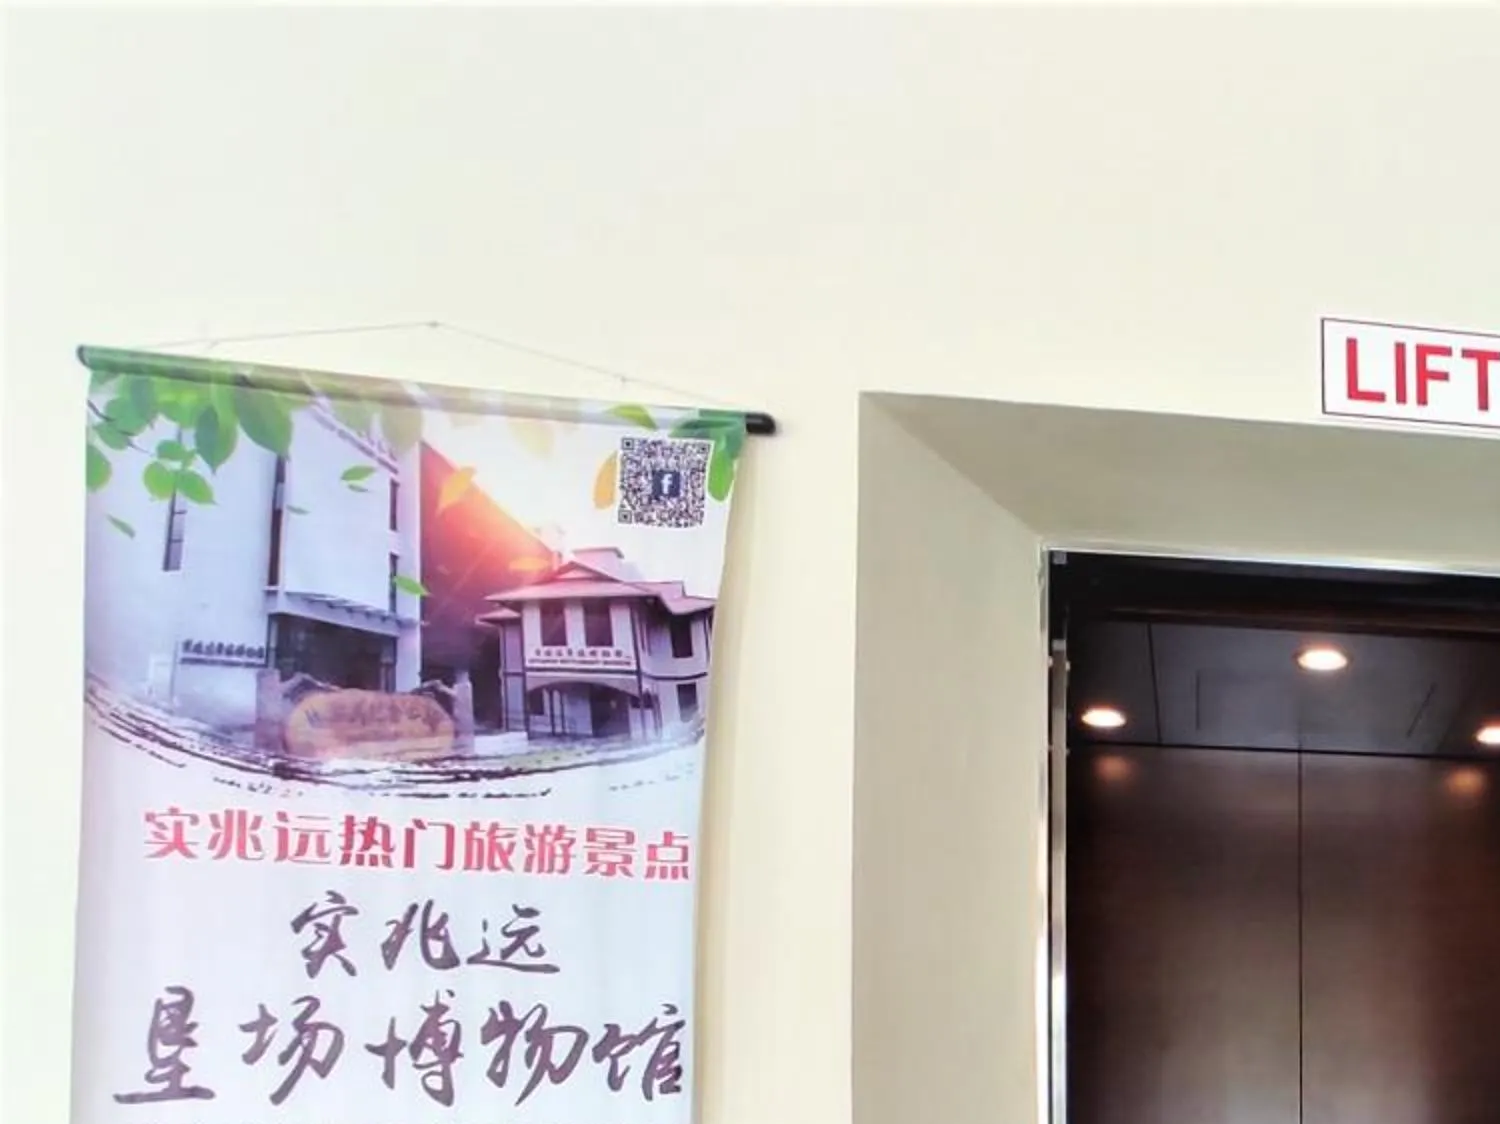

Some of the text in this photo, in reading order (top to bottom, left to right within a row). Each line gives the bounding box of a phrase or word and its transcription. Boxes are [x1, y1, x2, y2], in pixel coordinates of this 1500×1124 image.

[143, 806, 691, 881] 实兆远热门旅游景点
[291, 890, 561, 979] 实兆远
[113, 984, 687, 1107] 垦场博物馆
